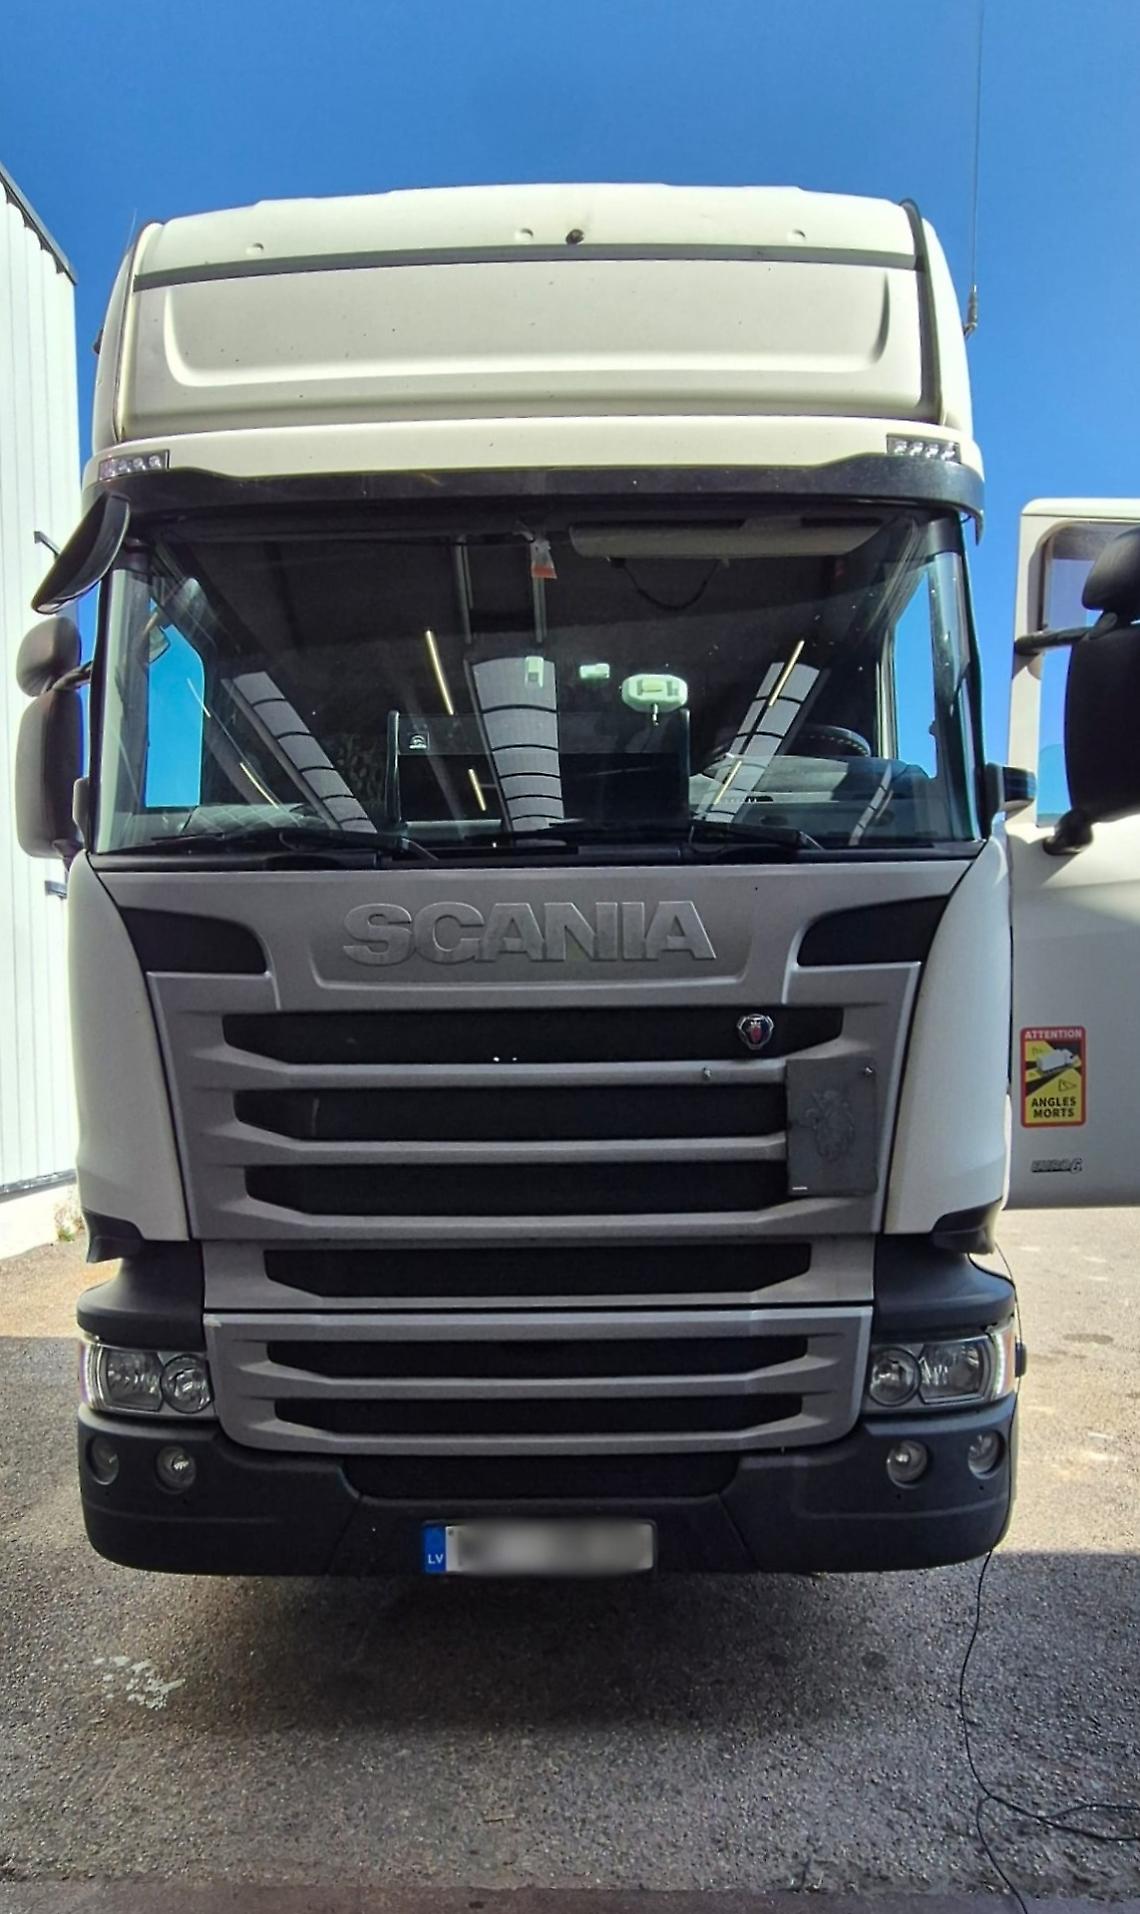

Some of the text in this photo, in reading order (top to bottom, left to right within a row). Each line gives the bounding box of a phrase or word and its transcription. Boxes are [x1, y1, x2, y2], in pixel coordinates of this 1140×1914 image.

[343, 901, 717, 966] SCANIA
[1025, 1029, 1082, 1040] ATTENTION
[1031, 1096, 1077, 1107] ANGLES
[1033, 1108, 1075, 1118] MORTS
[428, 1554, 444, 1564] LV
